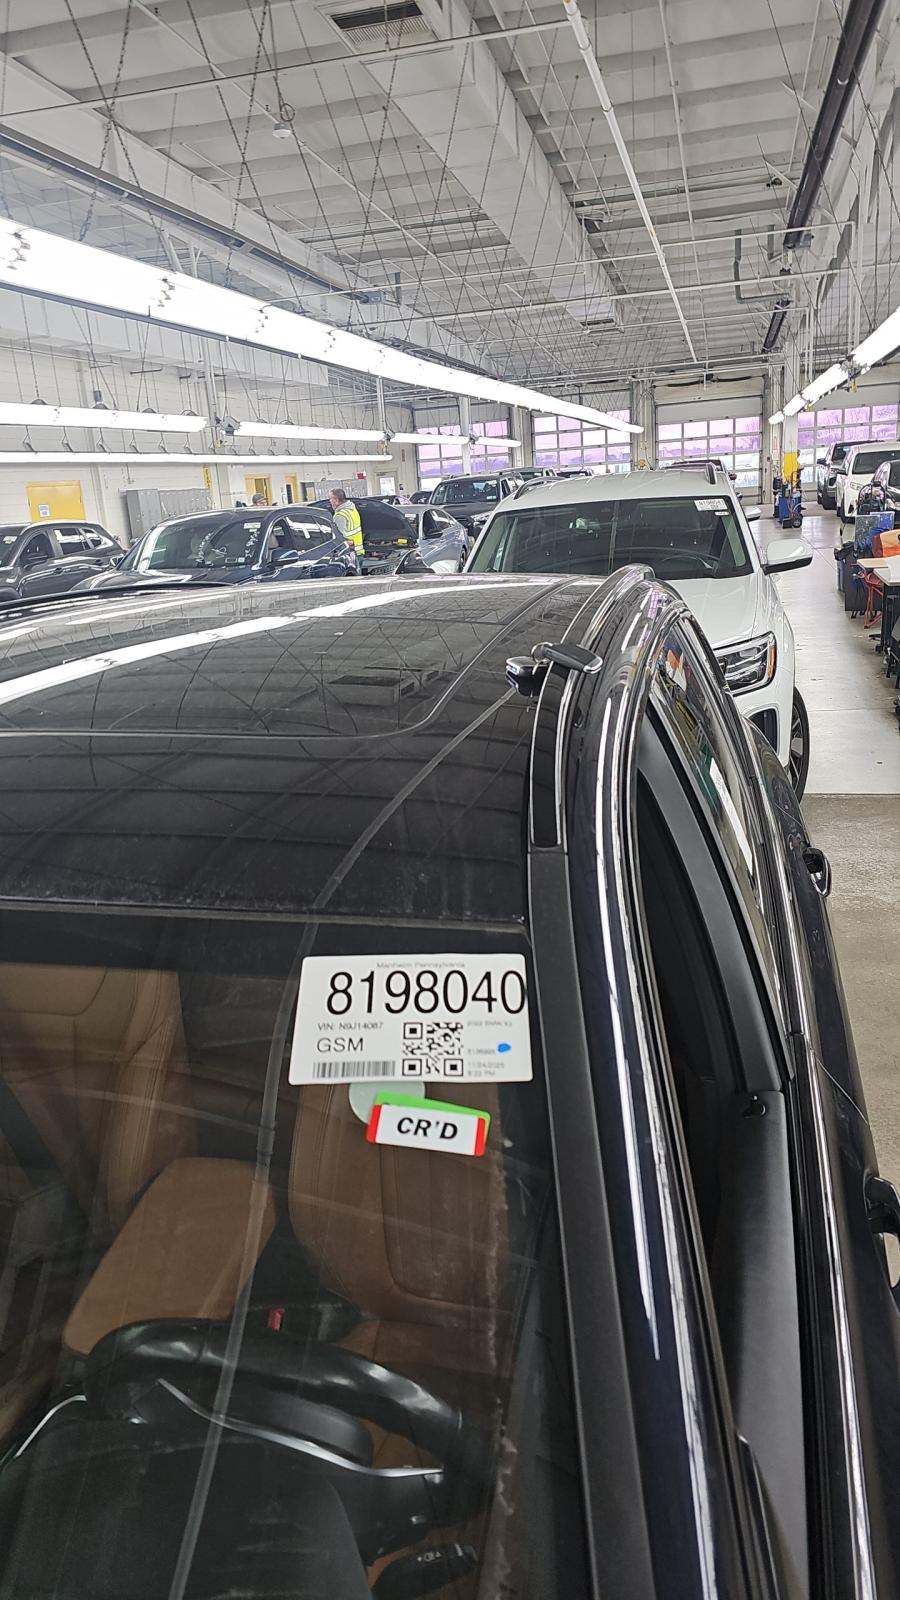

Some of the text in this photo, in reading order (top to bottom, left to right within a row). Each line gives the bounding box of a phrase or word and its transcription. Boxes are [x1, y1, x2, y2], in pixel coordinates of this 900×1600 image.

[327, 970, 527, 1015] 8198040
[316, 1037, 364, 1053] GSM
[396, 1116, 459, 1140] CR'D
